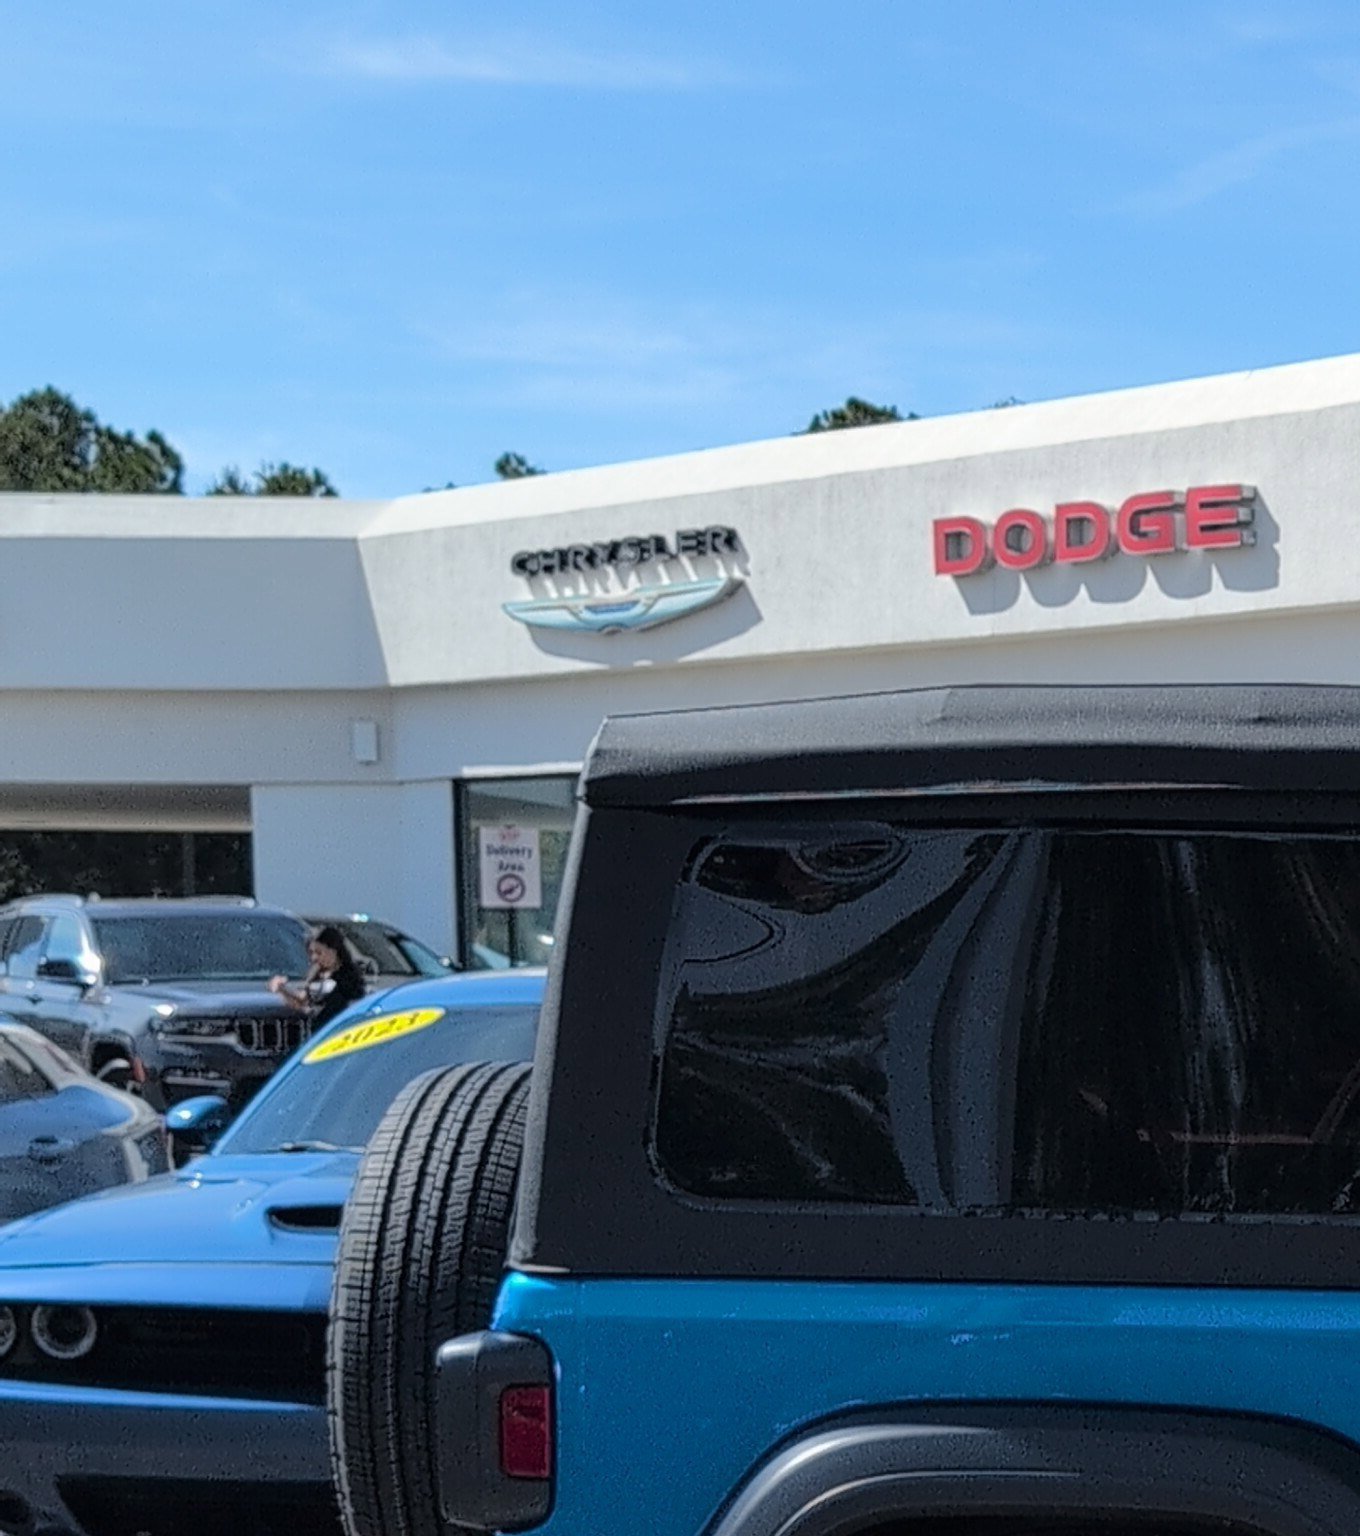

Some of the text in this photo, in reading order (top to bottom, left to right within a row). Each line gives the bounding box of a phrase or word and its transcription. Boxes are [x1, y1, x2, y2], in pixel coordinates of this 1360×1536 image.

[932, 483, 1257, 577] DODGE
[511, 525, 743, 577] CHRYSLER
[486, 844, 533, 859] Delivery
[498, 860, 525, 871] Area
